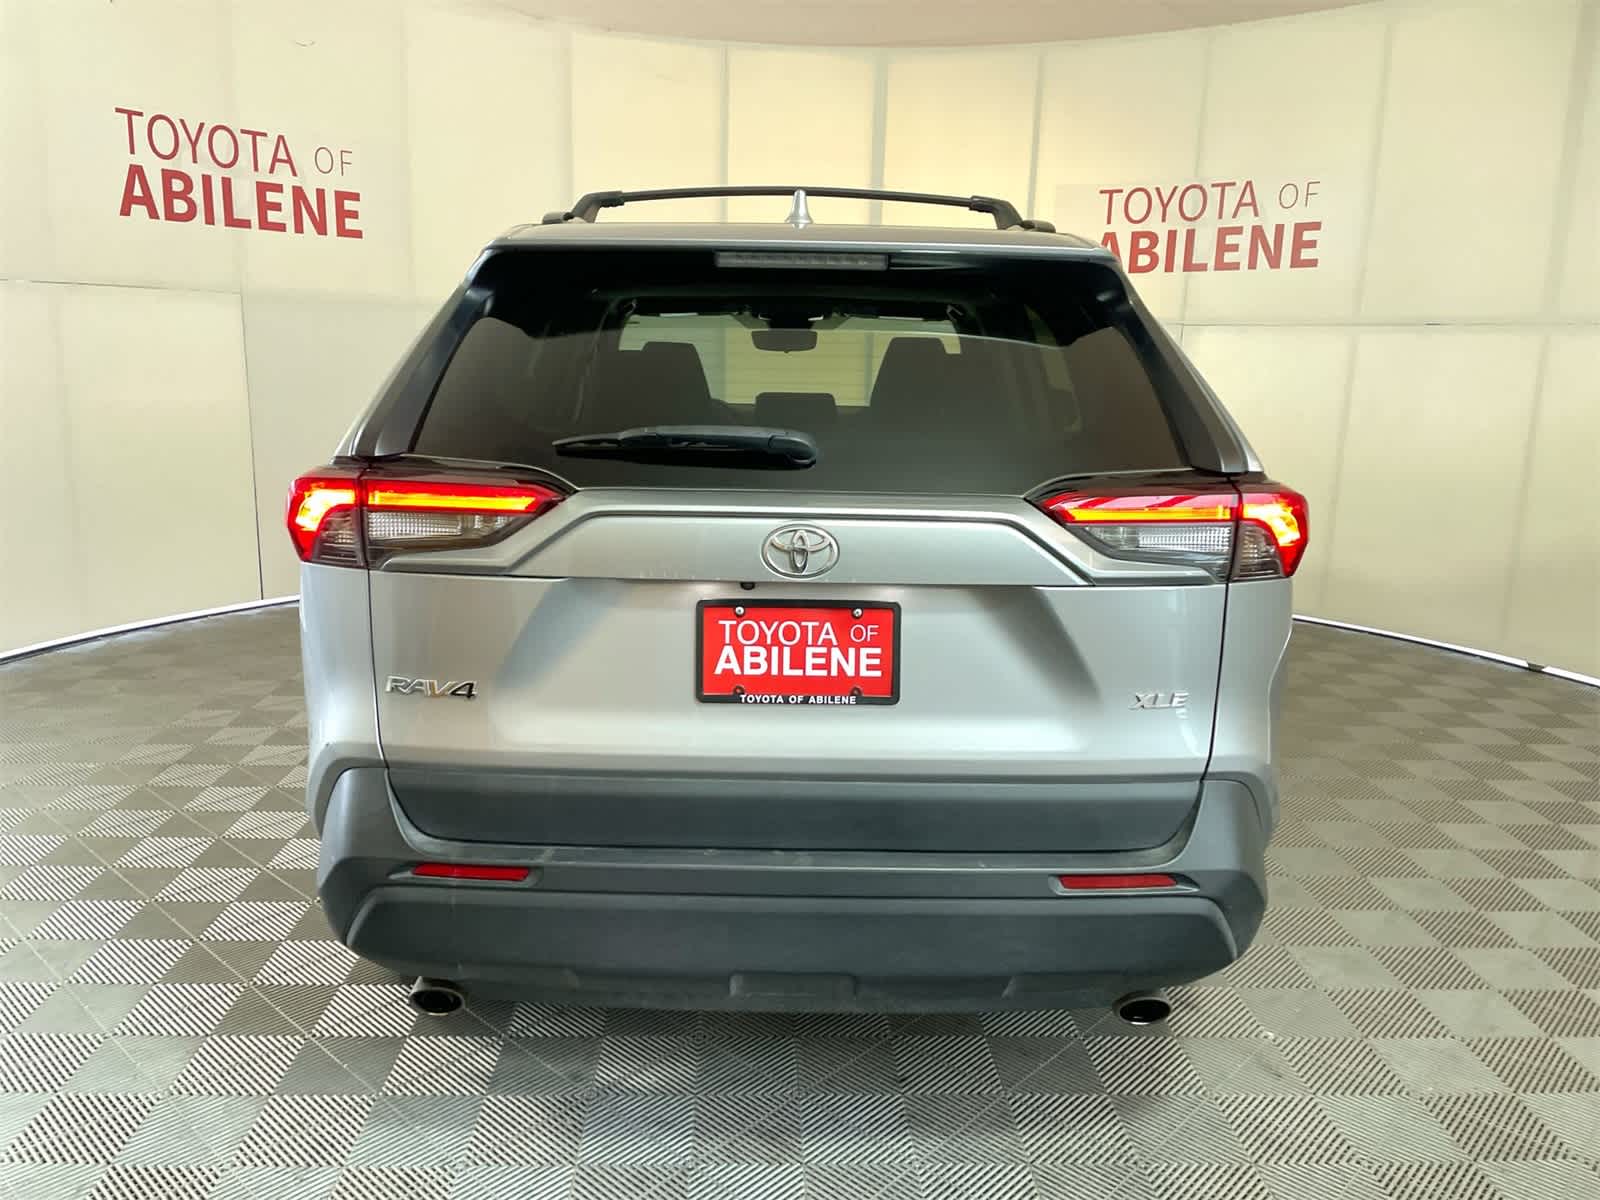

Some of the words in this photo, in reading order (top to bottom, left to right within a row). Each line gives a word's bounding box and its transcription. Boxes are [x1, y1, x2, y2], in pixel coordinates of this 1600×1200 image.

[115, 107, 298, 177] TOYOTA
[314, 147, 352, 176] OF
[119, 163, 363, 239] ABILENE
[1099, 180, 1259, 225] TOYOTA
[1279, 181, 1321, 209] OF
[718, 620, 838, 646] TOYOTA
[850, 625, 879, 643] OF
[714, 646, 882, 677] ABILENE
[385, 675, 477, 699] RAV4
[740, 694, 784, 704] TOYOTA
[788, 695, 804, 704] OF
[808, 696, 857, 705] ABILENE
[1128, 692, 1189, 709] XLE
